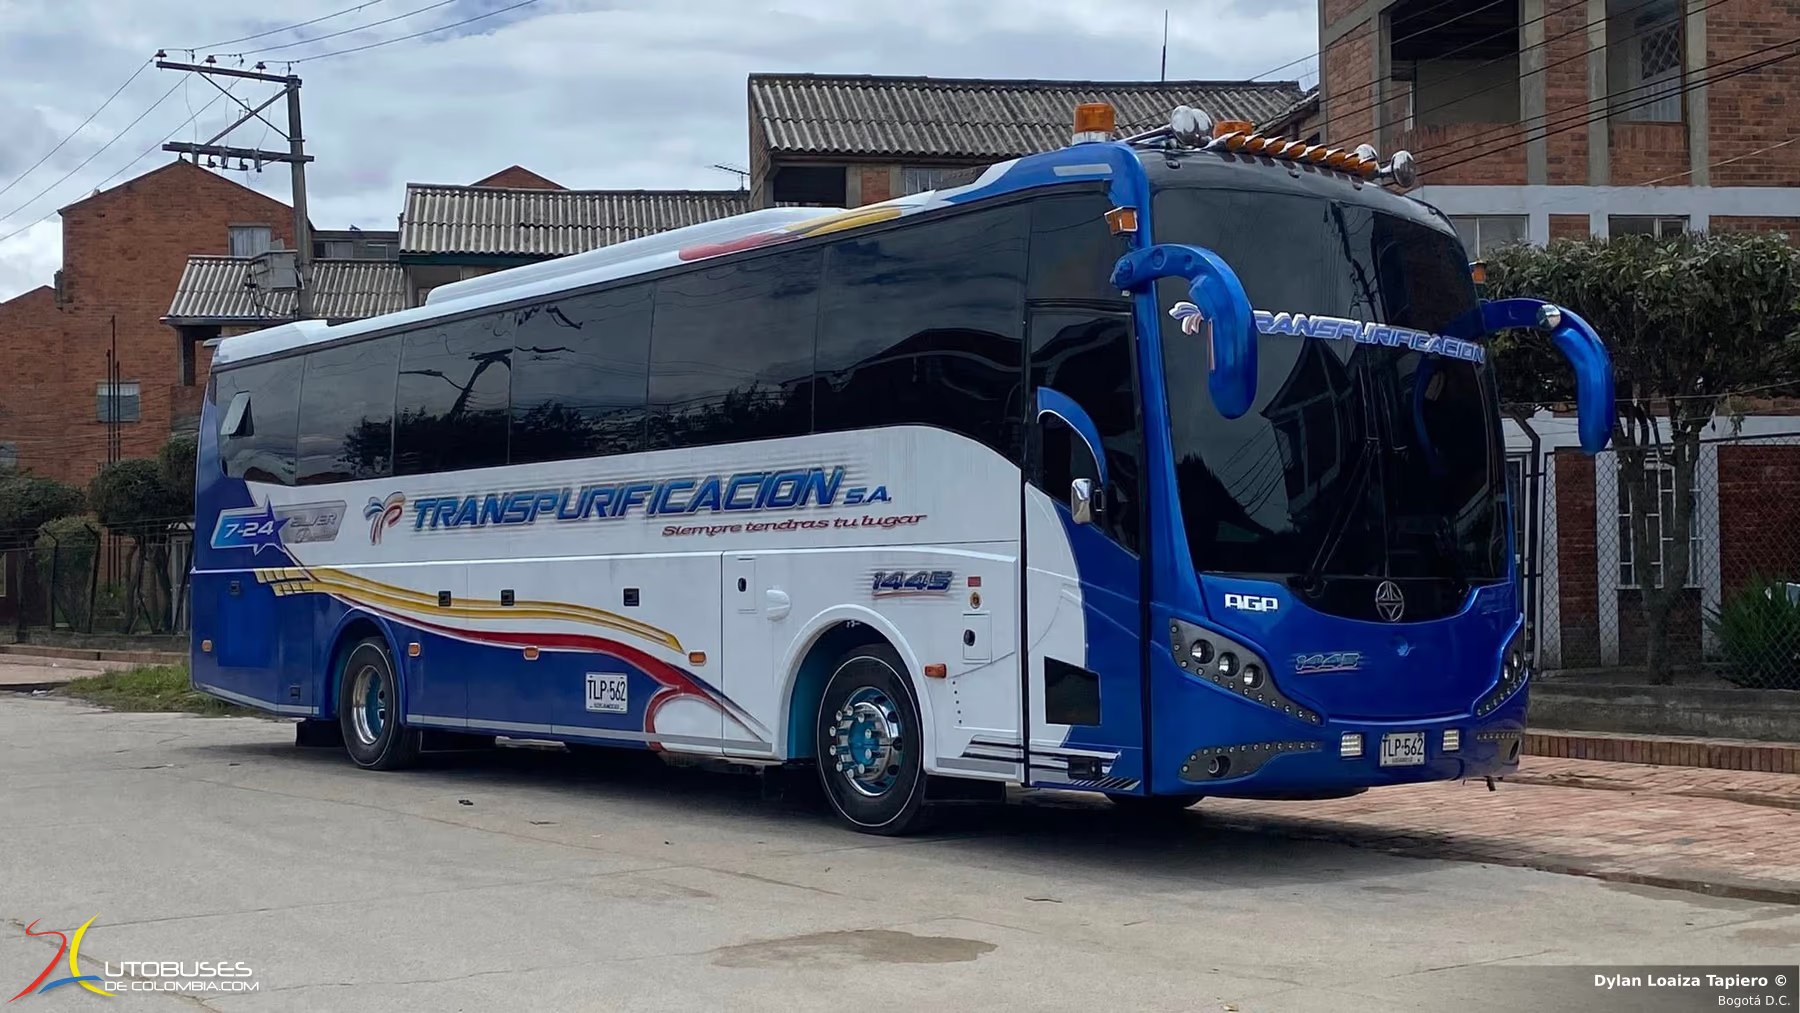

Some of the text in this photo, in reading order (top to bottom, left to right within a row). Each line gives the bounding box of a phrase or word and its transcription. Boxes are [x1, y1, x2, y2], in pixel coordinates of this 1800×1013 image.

[1253, 309, 1485, 363] RANSPURIFICACION
[413, 465, 846, 531] TRANSPURIFICACION
[223, 520, 274, 538] 7-24
[662, 514, 927, 537] Siempre tendras tu lugar
[871, 570, 952, 592] 1445
[1225, 593, 1278, 611] AGP
